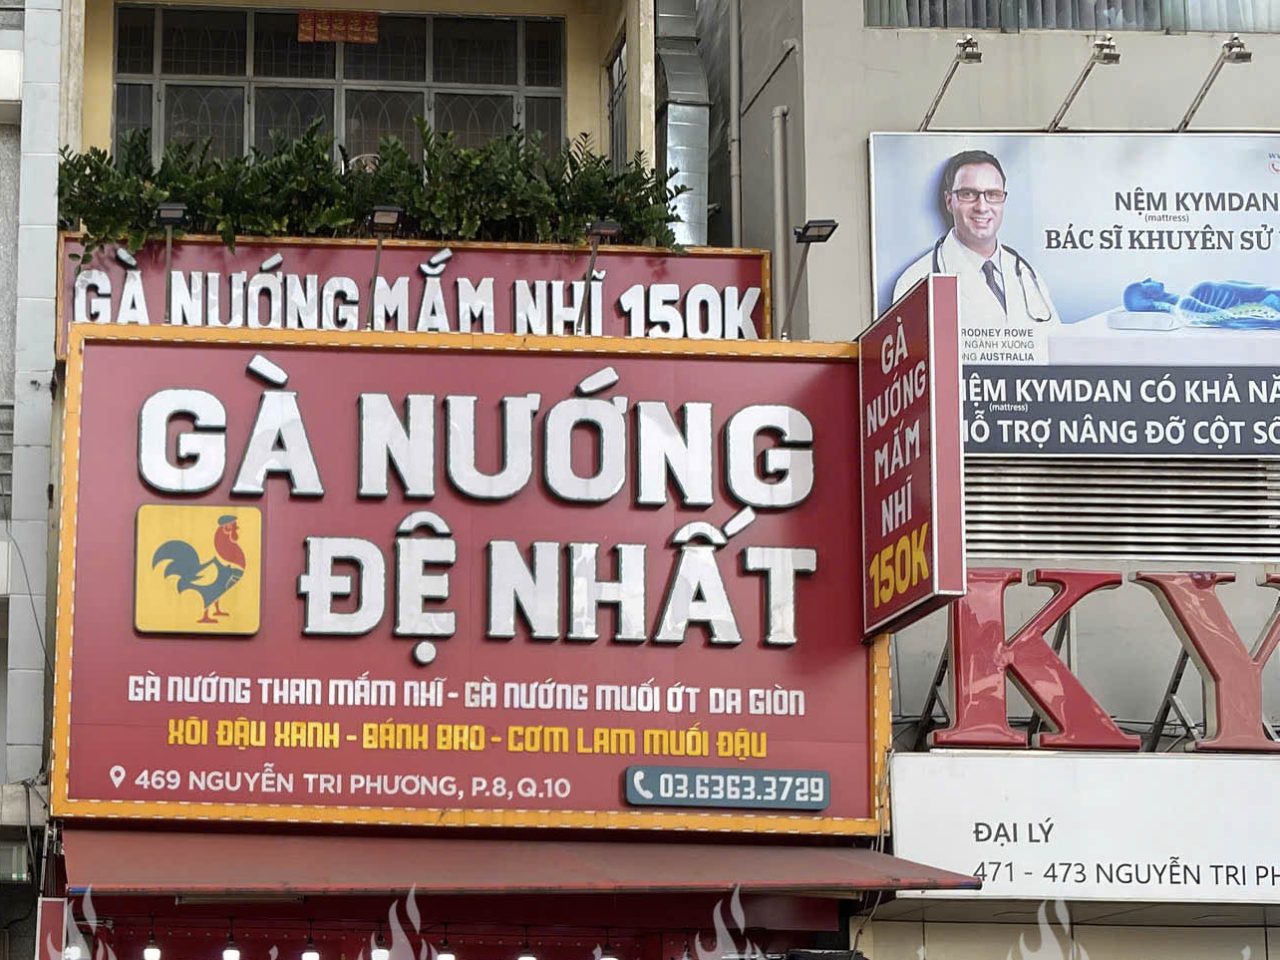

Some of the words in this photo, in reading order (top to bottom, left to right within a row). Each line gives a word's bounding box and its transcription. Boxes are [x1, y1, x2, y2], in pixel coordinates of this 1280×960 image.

[1115, 186, 1167, 216] NỆM
[1176, 192, 1278, 212] KYMDAN
[1144, 213, 1190, 223] (mattress)
[1045, 224, 1093, 250] BÁC
[1099, 225, 1122, 250] SĨ
[1128, 226, 1233, 250] KHUYÊN
[1240, 224, 1274, 250] SỬ
[74, 247, 148, 325] GÀ
[169, 253, 358, 331] NƯỚNG
[373, 247, 494, 334] MẮM
[513, 271, 606, 337] NHĨ
[620, 282, 764, 340] 150K
[881, 316, 909, 376] GÀ
[1004, 328, 1034, 337] ROWE
[980, 353, 1035, 361] AUSTRALIA
[867, 360, 926, 438] NƯỚNG
[1016, 379, 1131, 402] KYMDAN
[1140, 375, 1177, 402] CÓ
[1185, 373, 1240, 403] KHẢ
[989, 403, 1029, 413] (mattress)
[138, 354, 324, 495] GÀ
[359, 366, 814, 508] NƯỚNG
[997, 418, 1052, 449] TRỢ
[1060, 413, 1138, 443] NÂNG
[1145, 412, 1187, 444] ĐỠ
[1193, 414, 1245, 450] CỘT
[874, 418, 921, 487] MẮM
[881, 475, 913, 537] NHĨ
[869, 522, 929, 609] 150K
[299, 510, 457, 665] ĐỆ
[487, 507, 817, 645] NHẤT
[927, 568, 1280, 752] KY
[128, 670, 160, 701] GÀ
[167, 671, 251, 703] NƯỚNG
[258, 678, 322, 705] THAN
[328, 671, 396, 706] MẮM
[404, 677, 447, 707] NHĨ
[465, 676, 498, 708] GÀ
[504, 678, 588, 710] NƯỚNG
[596, 678, 660, 712] MUỐI
[667, 682, 700, 713] ỚT
[709, 688, 741, 715] DA
[749, 683, 806, 716] GIÒN
[168, 716, 208, 746] XÔI
[216, 717, 266, 750] ĐẬU
[274, 721, 340, 748] XANH
[362, 718, 428, 750] BÁNH
[436, 724, 486, 751] BAO
[508, 724, 569, 752] CƠM
[578, 728, 635, 754] LAM
[644, 721, 709, 757] MUỐI
[716, 729, 767, 761] ĐẬU
[135, 770, 181, 790] 469
[189, 762, 294, 793] NGUYỄN
[304, 773, 342, 793] TRI
[350, 773, 465, 800] PHƯƠNG,
[660, 773, 824, 802] 03.6363.3729
[973, 823, 1018, 847] ĐẠI
[1028, 817, 1054, 843] LÝ
[973, 861, 1015, 882] 471
[1043, 862, 1087, 883] 473
[1096, 856, 1200, 885] NGUYỄN
[1210, 865, 1246, 886] TRI
